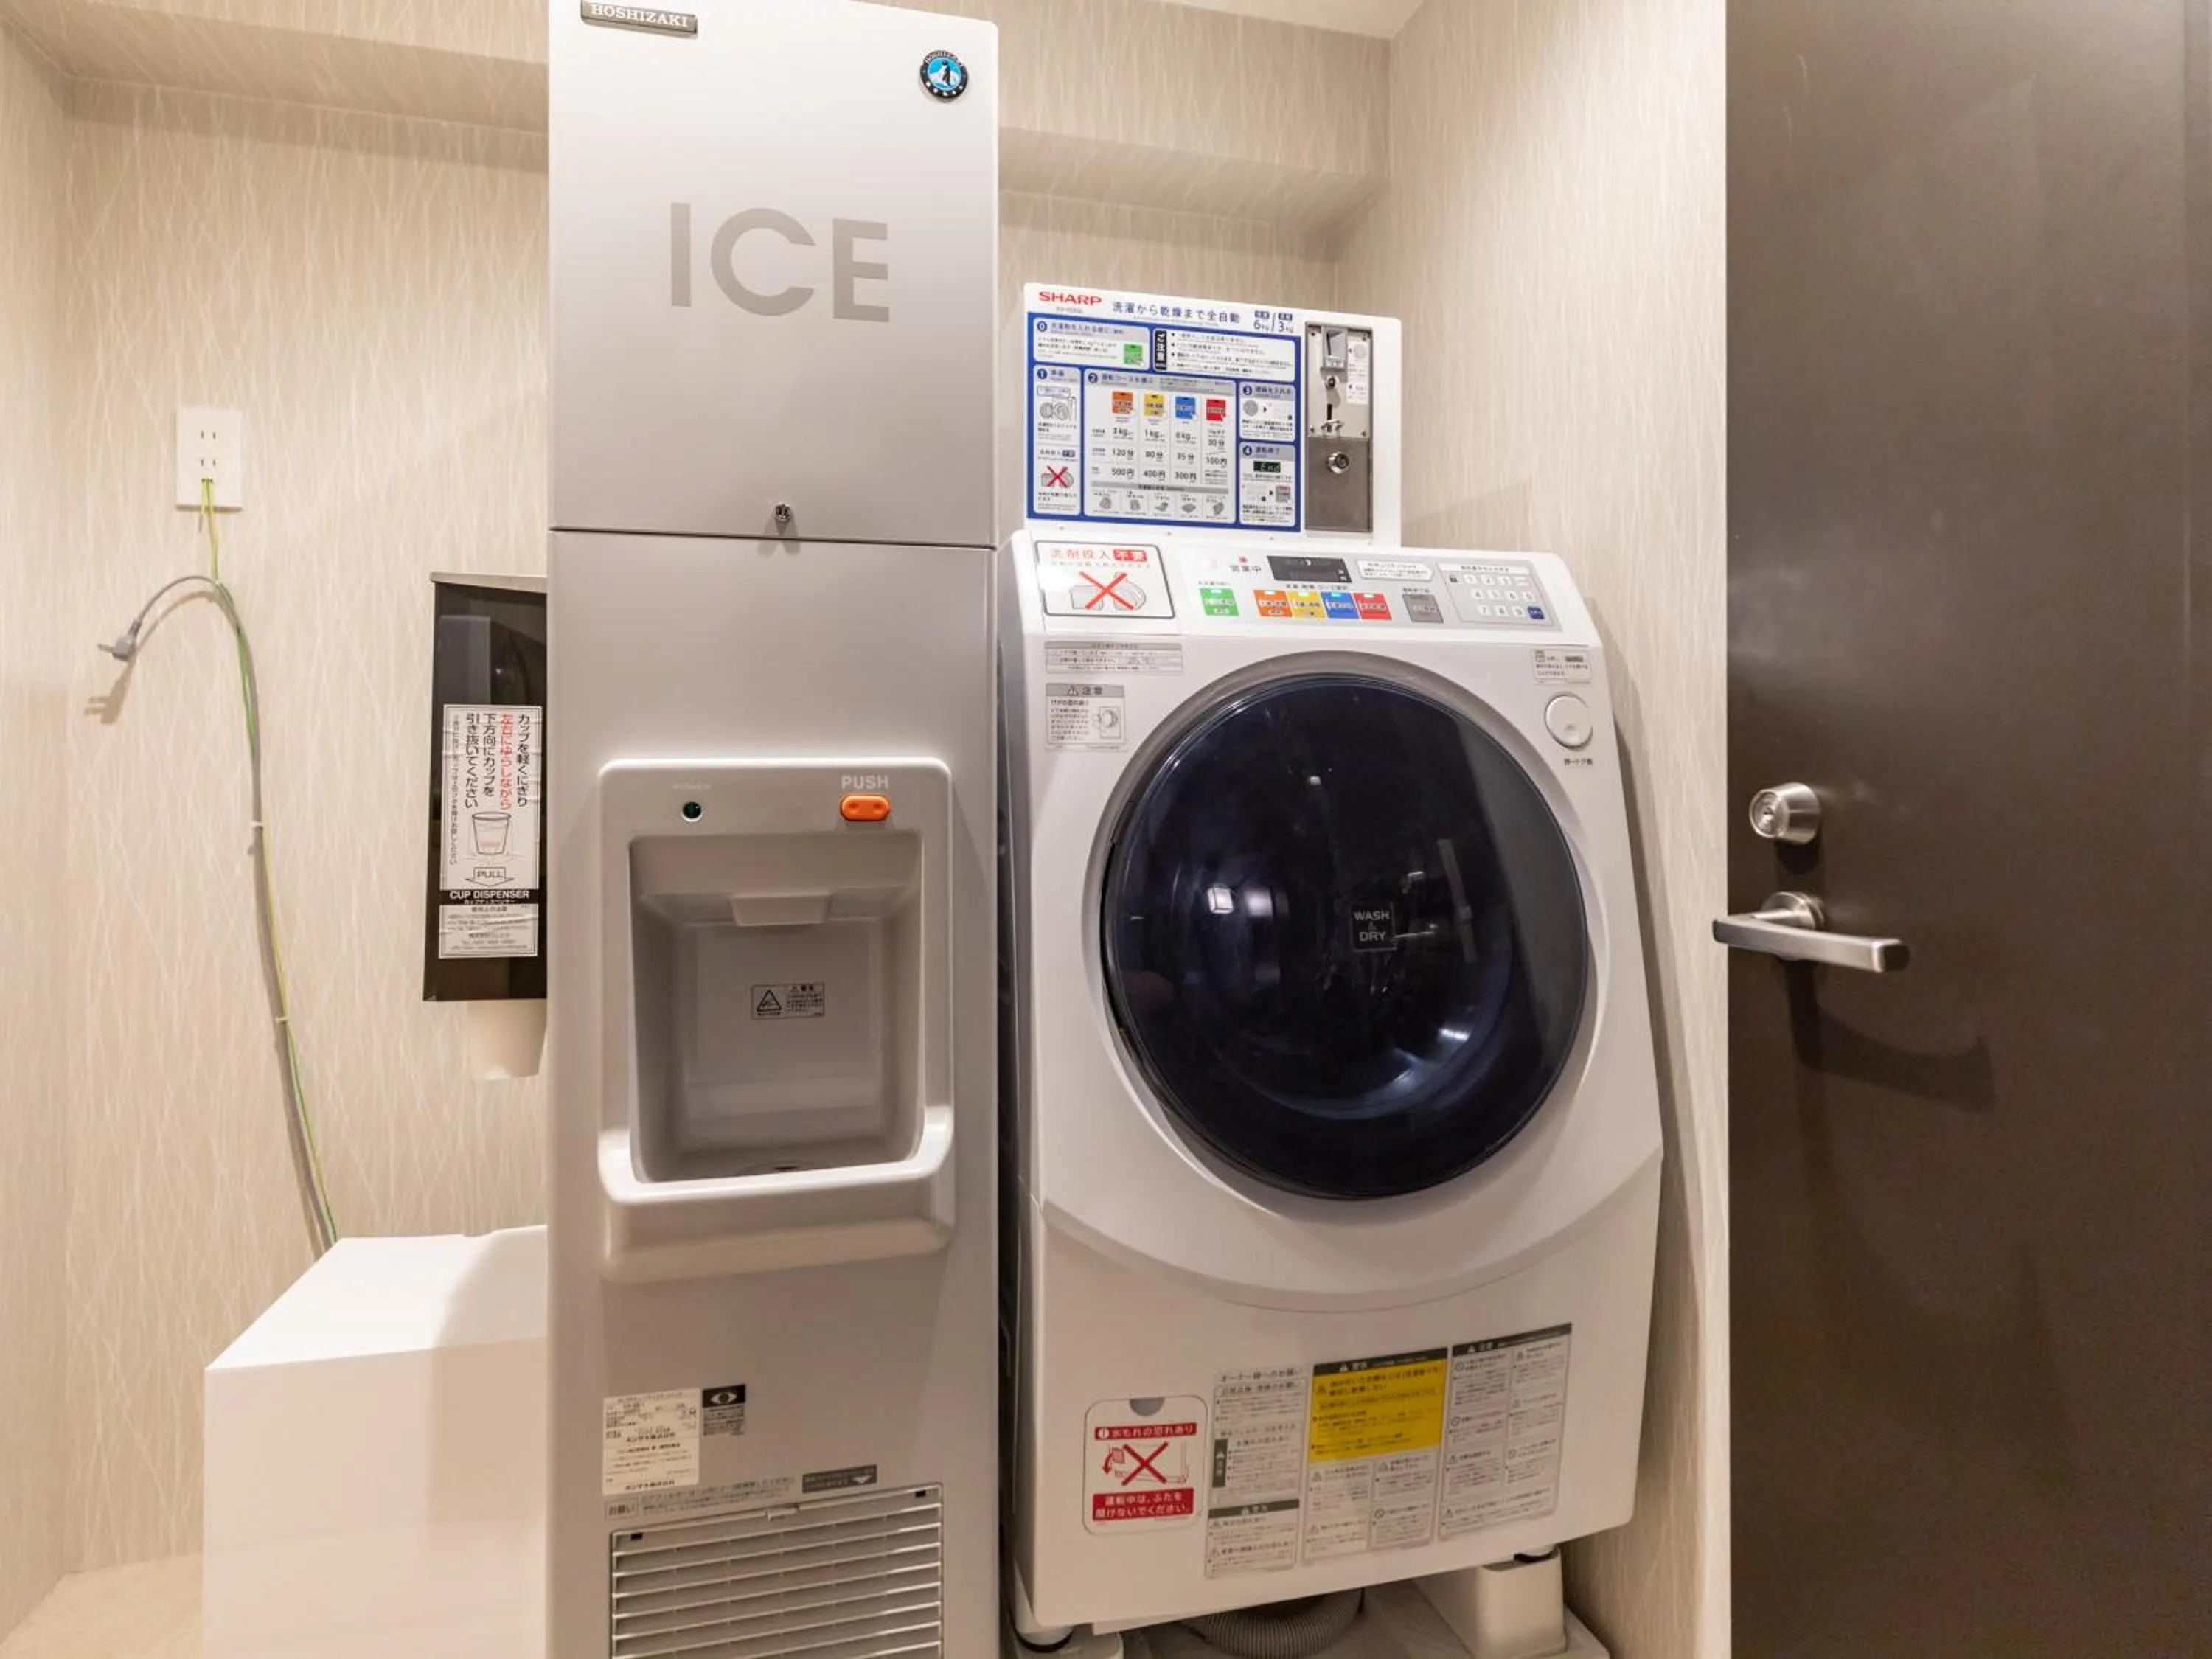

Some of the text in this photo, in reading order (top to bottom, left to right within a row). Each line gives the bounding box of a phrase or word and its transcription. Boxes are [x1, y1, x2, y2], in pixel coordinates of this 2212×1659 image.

[591, 4, 689, 27] HOSHIZAKI
[670, 202, 890, 323] ICE
[1038, 291, 1102, 306] SHARP
[1112, 301, 1239, 323] 洗濯から乾燥まで全自動
[483, 713, 496, 797] 下方向にカップを
[500, 714, 514, 810] 左右にゆらしながら
[517, 714, 530, 807] カップを軽くにぎり
[841, 775, 889, 790] PUSH
[477, 869, 503, 879] PULL
[449, 890, 529, 899] CUP DISPENSER
[1354, 911, 1390, 921] WASH
[1359, 931, 1385, 942] DRY
